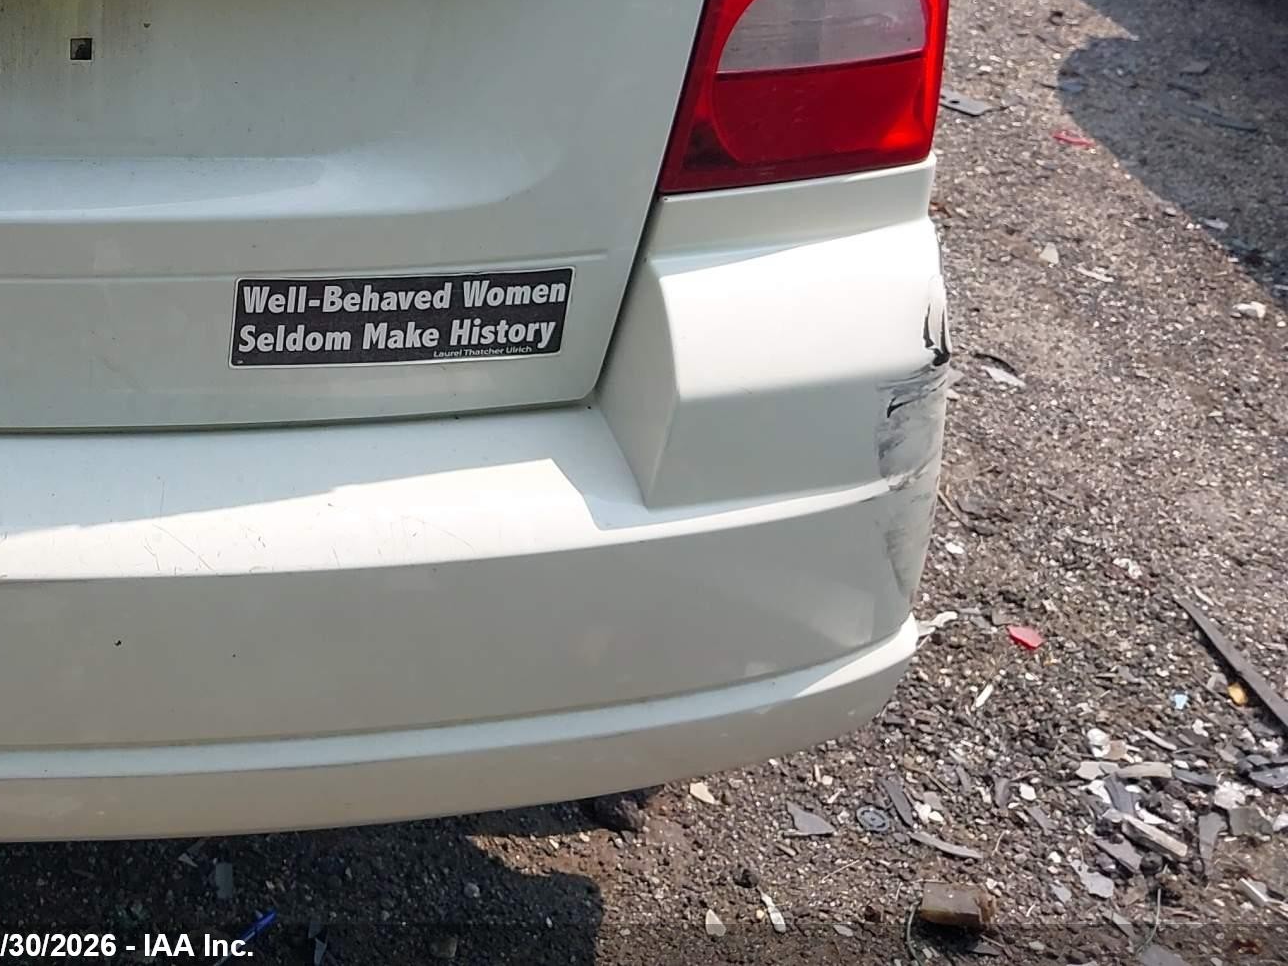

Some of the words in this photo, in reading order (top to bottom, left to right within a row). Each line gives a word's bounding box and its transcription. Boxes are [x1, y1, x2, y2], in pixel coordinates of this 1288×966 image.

[243, 281, 453, 314] Well-Behaved
[462, 279, 567, 309] Women
[238, 324, 352, 353] Seldom
[362, 321, 440, 351] Make
[449, 318, 557, 349] History
[433, 350, 462, 358] Laurel
[464, 348, 504, 357] Thatcher
[506, 345, 533, 354] Ulrich
